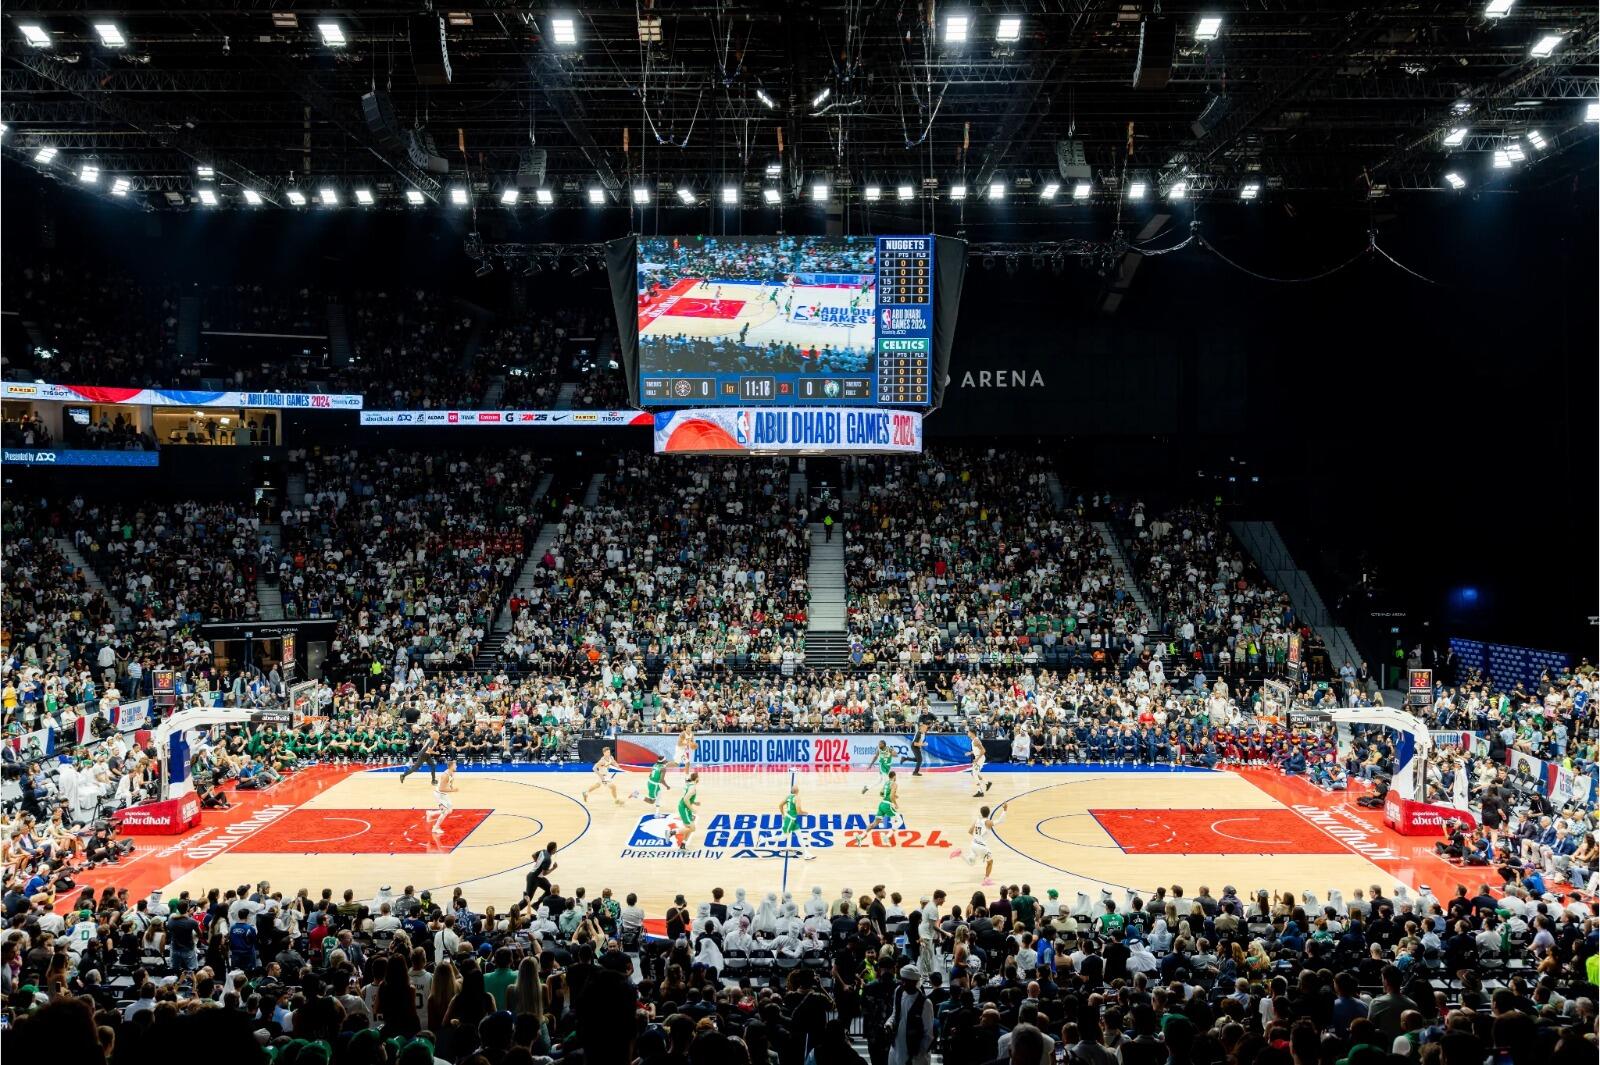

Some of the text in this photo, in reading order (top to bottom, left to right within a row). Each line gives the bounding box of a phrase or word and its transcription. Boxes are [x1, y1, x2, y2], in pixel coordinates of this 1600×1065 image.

[886, 240, 924, 250] NUGGETS
[892, 319, 926, 329] GAMES 2024
[883, 341, 924, 350] CELTICS
[961, 370, 1044, 388] ARENA
[702, 381, 708, 396] 0
[806, 381, 812, 396] 0
[286, 395, 309, 406] GAMES
[312, 396, 330, 407] 2024
[754, 412, 915, 446] ABU DHABI GAMES 2024
[4, 452, 28, 460] Presented
[29, 453, 34, 462] by
[694, 740, 720, 762] ABU
[723, 740, 762, 762] DHABI
[767, 740, 810, 762] GAMES
[815, 739, 850, 762] 2024
[854, 745, 877, 755] Presente
[123, 816, 170, 824] abu dhabi
[707, 814, 783, 830] ABU
[1412, 816, 1432, 825] abu
[844, 831, 952, 848] 2024
[705, 850, 724, 860] by
[82, 930, 89, 940] 0
